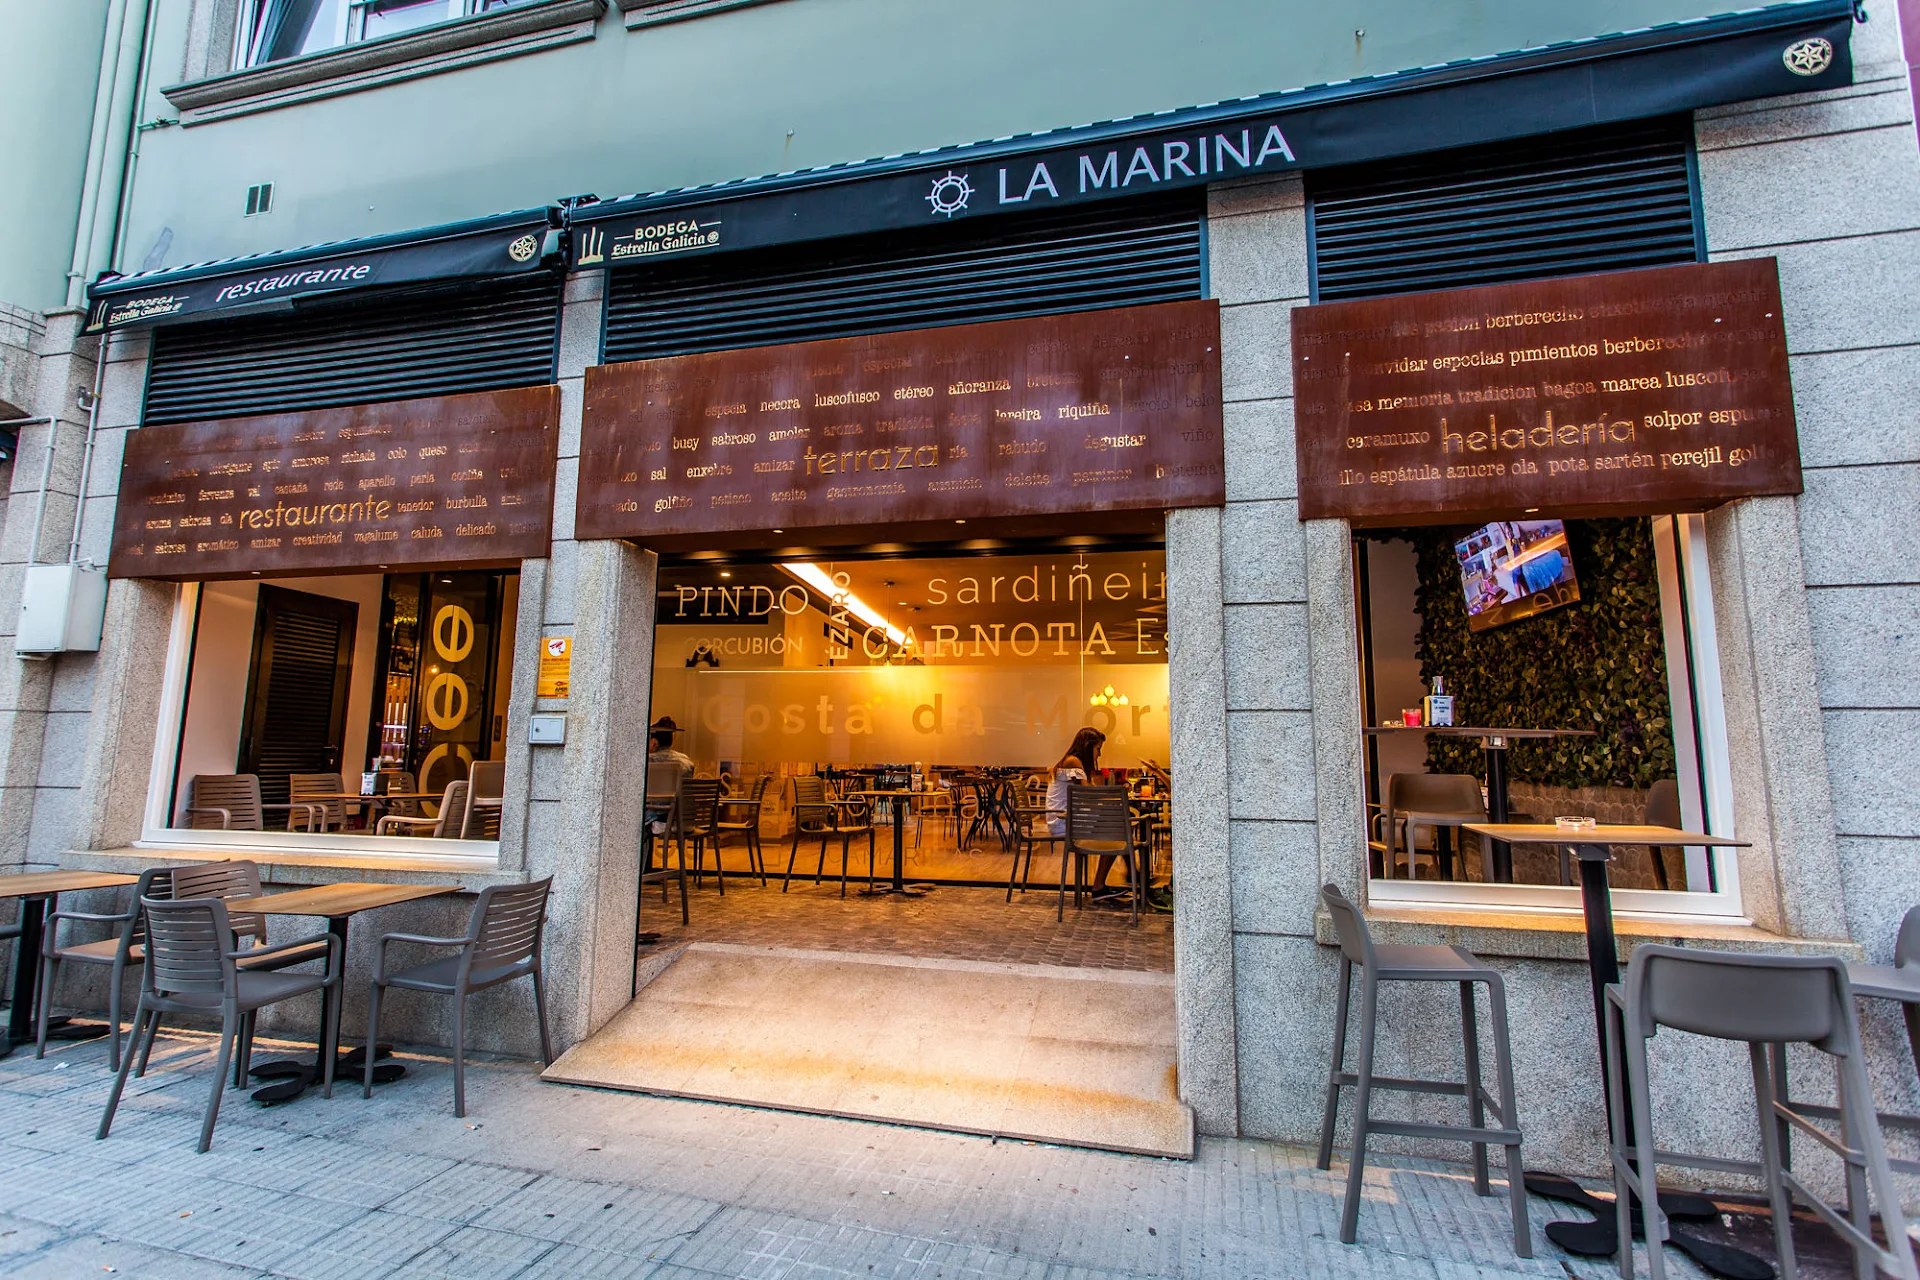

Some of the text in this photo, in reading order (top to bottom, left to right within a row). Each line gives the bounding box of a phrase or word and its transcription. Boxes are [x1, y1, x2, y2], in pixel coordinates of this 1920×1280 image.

[999, 125, 1296, 204] LA MARINA
[611, 233, 705, 257] Estrella Galicia
[634, 219, 699, 241] BODEGA
[215, 264, 371, 302] restaurante
[109, 308, 140, 323] Estrella
[126, 296, 175, 308] BODEGA
[1486, 305, 1583, 330] berberecho
[1354, 358, 1428, 377] onvidar
[1433, 350, 1504, 372] especias
[1509, 342, 1598, 368] pimientos
[705, 401, 747, 419] especia
[760, 396, 801, 413] necora
[815, 390, 881, 408] luscofusco
[894, 384, 935, 402] etéreo
[948, 378, 1012, 396] añoranza
[1378, 391, 1453, 411] memoria
[1542, 378, 1596, 399] bagoa
[1600, 373, 1662, 393] marea
[673, 435, 700, 453] buey
[711, 431, 757, 447] sabroso
[768, 426, 811, 442] amolar
[823, 422, 864, 437] aroma
[1058, 401, 1111, 421] riquiña
[1185, 392, 1215, 408] belo
[1346, 429, 1431, 450] caramuxo
[1441, 410, 1636, 454] heladería
[1643, 410, 1704, 431] solpor
[388, 446, 407, 460] colo
[419, 444, 447, 460] queso
[650, 467, 667, 481] sal
[686, 463, 733, 479] enxebre
[753, 459, 796, 473] amizar
[803, 444, 939, 476] terraza
[998, 438, 1047, 456] rabudo
[1084, 431, 1148, 452] degustar
[1181, 427, 1214, 443] viño
[1301, 469, 1365, 488] cucillo
[1370, 462, 1441, 487] espátula
[1446, 460, 1506, 479] azucre
[1511, 458, 1538, 475] ola
[1548, 456, 1589, 478] pota
[1594, 450, 1656, 471] sartén
[1660, 445, 1723, 471] perejil
[274, 481, 308, 496] castaña
[323, 478, 344, 492] rede
[358, 475, 396, 490] aparello
[771, 488, 807, 502] aceite
[145, 518, 172, 529] aroma
[178, 514, 212, 528] sabrosa
[239, 494, 393, 530] restaurante
[397, 498, 434, 513] tenedor
[445, 493, 488, 511] burbulla
[196, 537, 239, 553] aromático
[251, 535, 282, 550] amizar
[292, 531, 343, 548] creatividad
[354, 531, 398, 547] vagalume
[411, 525, 443, 540] caluda
[455, 520, 497, 538] delicado
[675, 585, 809, 617] PINDO
[826, 571, 851, 660] ÉZARO
[685, 633, 803, 655] CORCUBIÓN
[862, 622, 1117, 659] CARNOTA
[702, 693, 1170, 737] Costa da Mor
